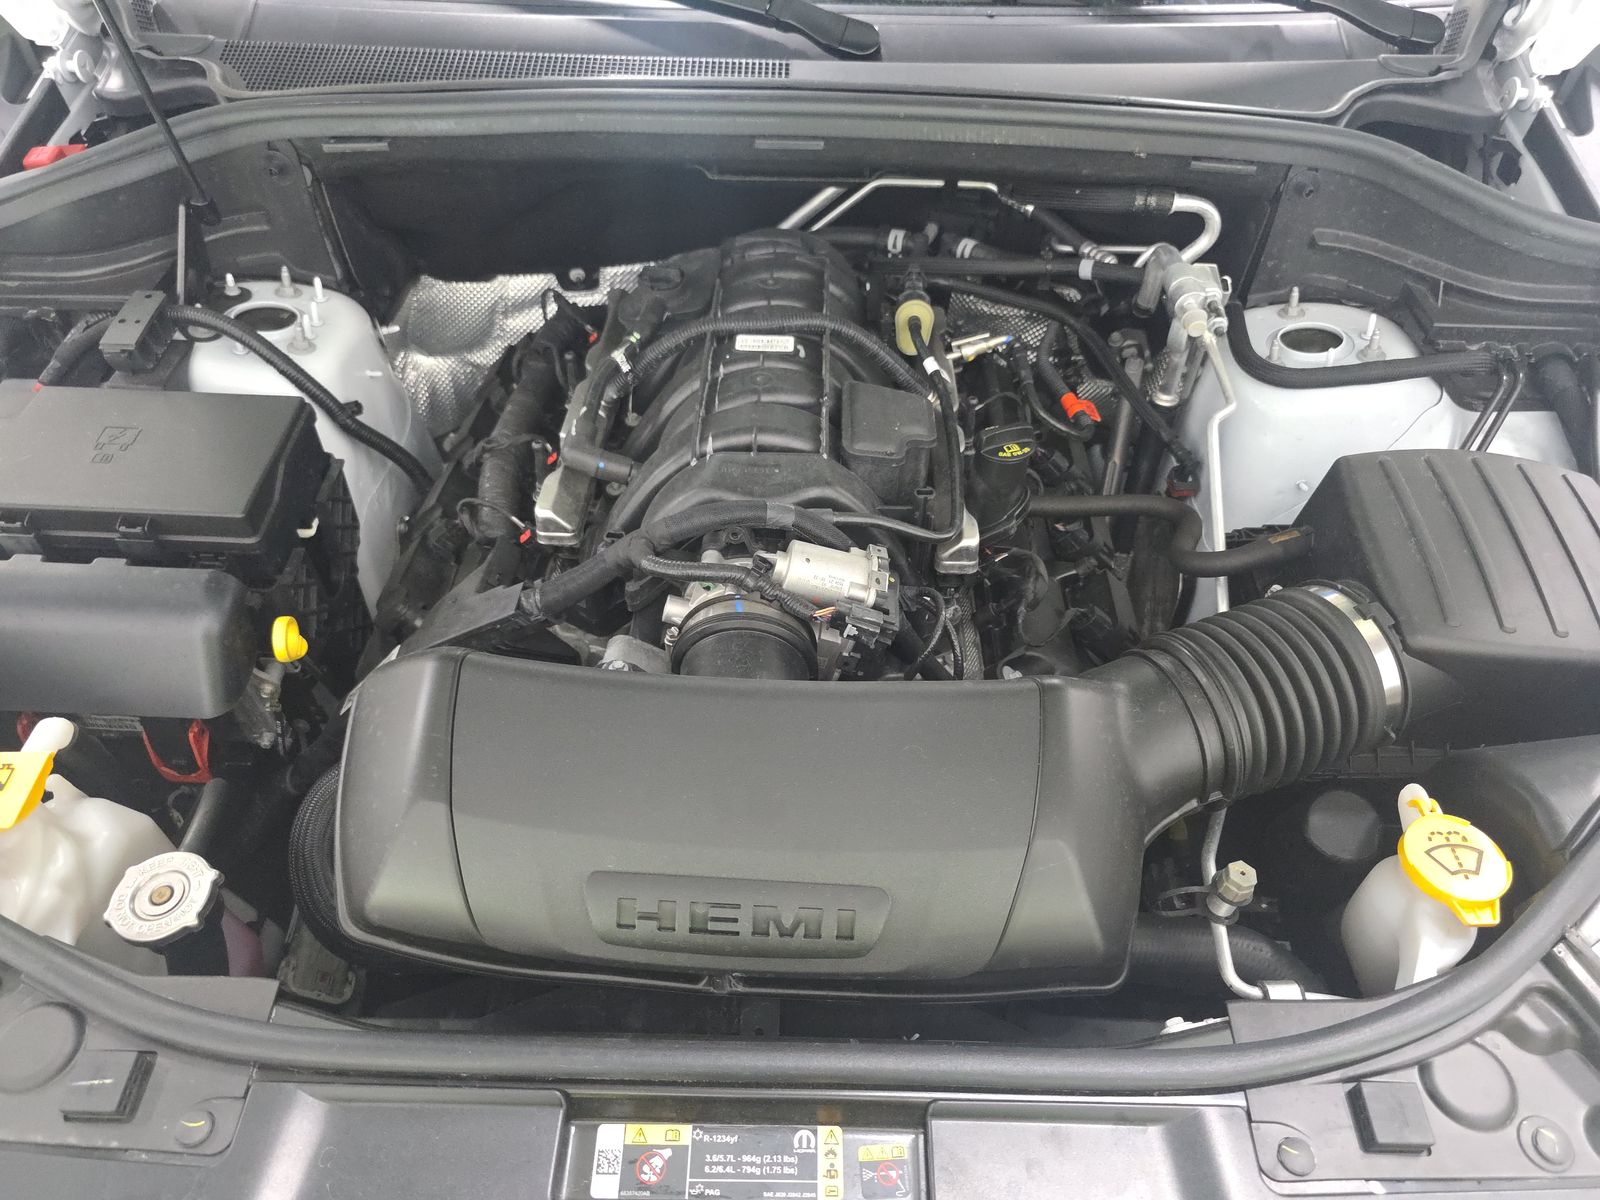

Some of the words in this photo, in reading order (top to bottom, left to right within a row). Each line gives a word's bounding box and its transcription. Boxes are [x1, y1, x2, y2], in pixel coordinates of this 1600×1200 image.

[616, 897, 857, 941] HEMI
[138, 919, 173, 934] OPEN
[703, 1134, 739, 1144] R-1234yf
[705, 1154, 736, 1163] 3.6/5.7L
[742, 1155, 761, 1165] 964g
[763, 1155, 782, 1164] (2.13
[783, 1155, 798, 1164] lbs)
[704, 1165, 736, 1174] 6.2/6.4L
[742, 1166, 761, 1175] 794g
[763, 1166, 782, 1175] (1.75
[783, 1166, 798, 1175] lbs)
[705, 1188, 721, 1196] PAG
